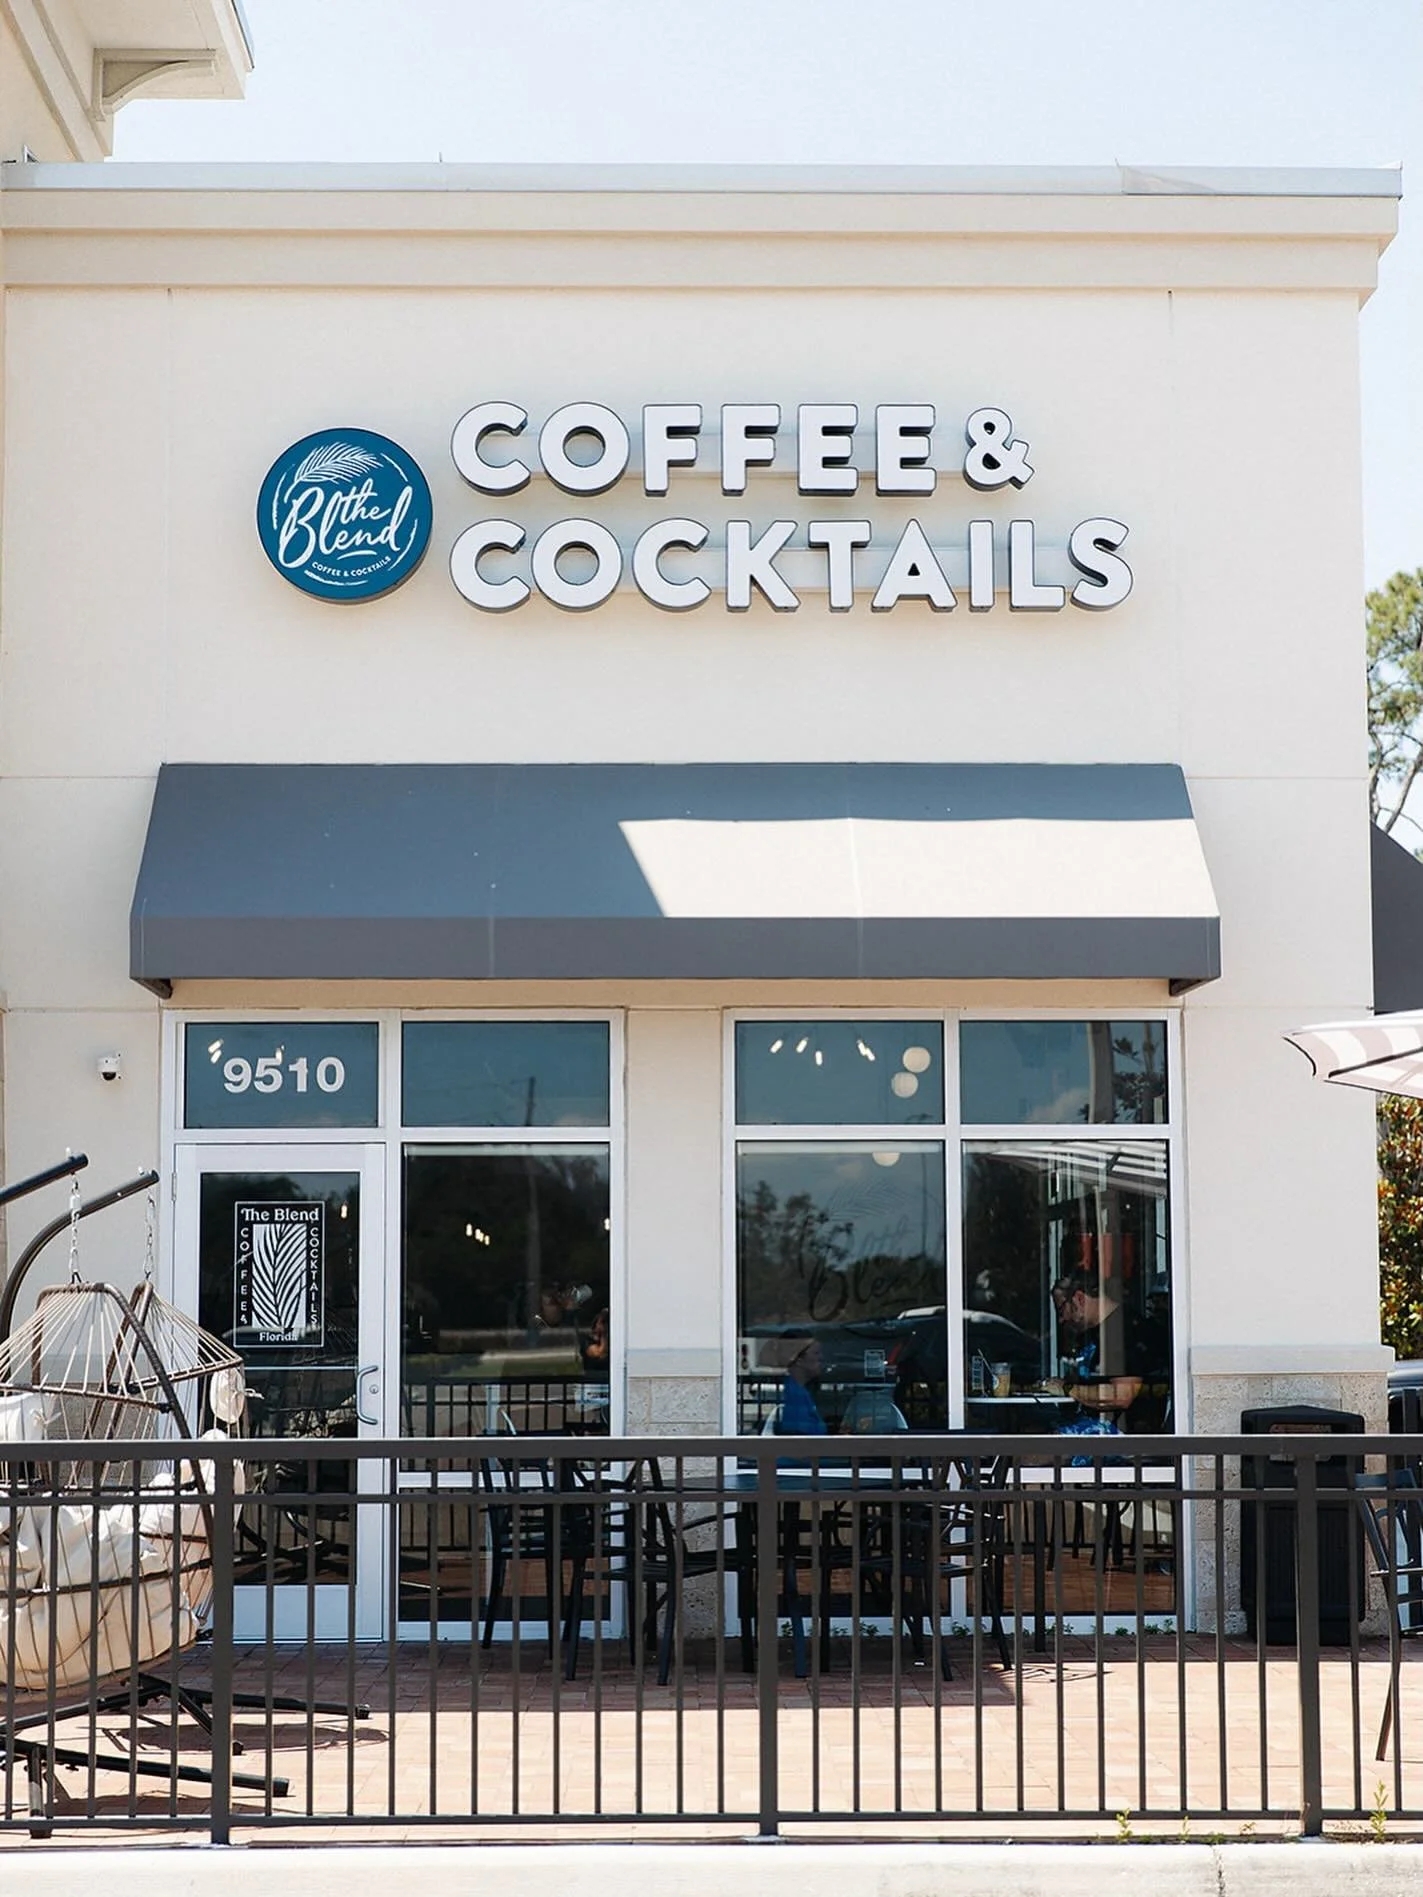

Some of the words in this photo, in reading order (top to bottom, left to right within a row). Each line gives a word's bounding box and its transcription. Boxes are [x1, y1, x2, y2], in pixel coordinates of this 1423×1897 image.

[450, 401, 937, 497] COFFEE
[963, 407, 1035, 491] &
[340, 477, 392, 525] the
[278, 485, 413, 569] Blend
[311, 561, 342, 577] COFFEE
[350, 555, 392, 577] COCKTAILS
[449, 518, 1134, 613] COCKTAILS
[223, 1056, 345, 1094] 9510
[240, 1208, 271, 1221] The
[274, 1207, 320, 1221] Blend
[309, 1227, 319, 1325] COCKTAILS
[259, 1331, 299, 1342] Florida
